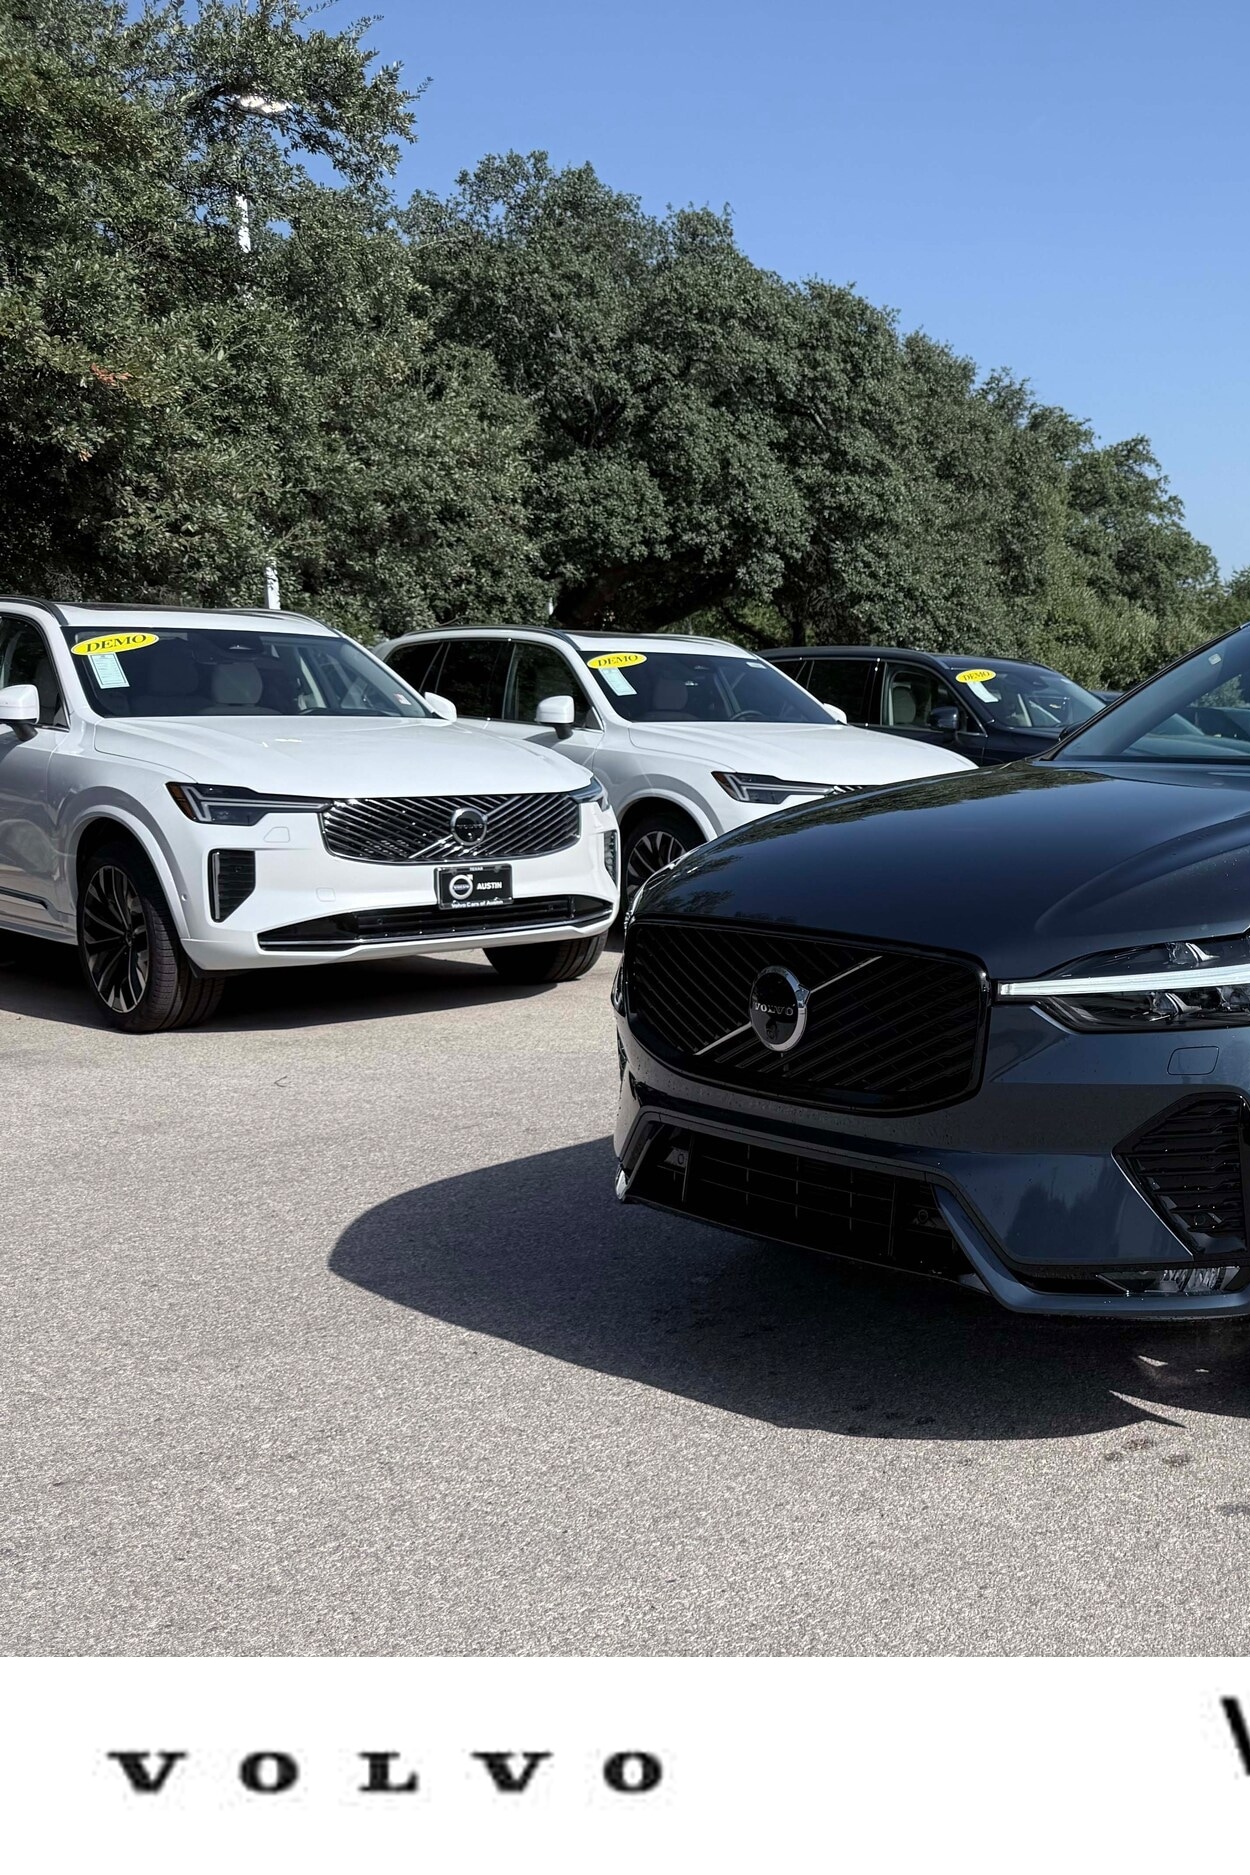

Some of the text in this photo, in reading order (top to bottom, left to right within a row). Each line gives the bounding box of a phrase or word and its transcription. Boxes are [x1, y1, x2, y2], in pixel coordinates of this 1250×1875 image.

[86, 634, 147, 653] DEMO
[597, 654, 639, 667] DEMO
[963, 670, 991, 681] DEMO
[476, 881, 503, 890] AUSTIN
[753, 1002, 794, 1015] VOLVO
